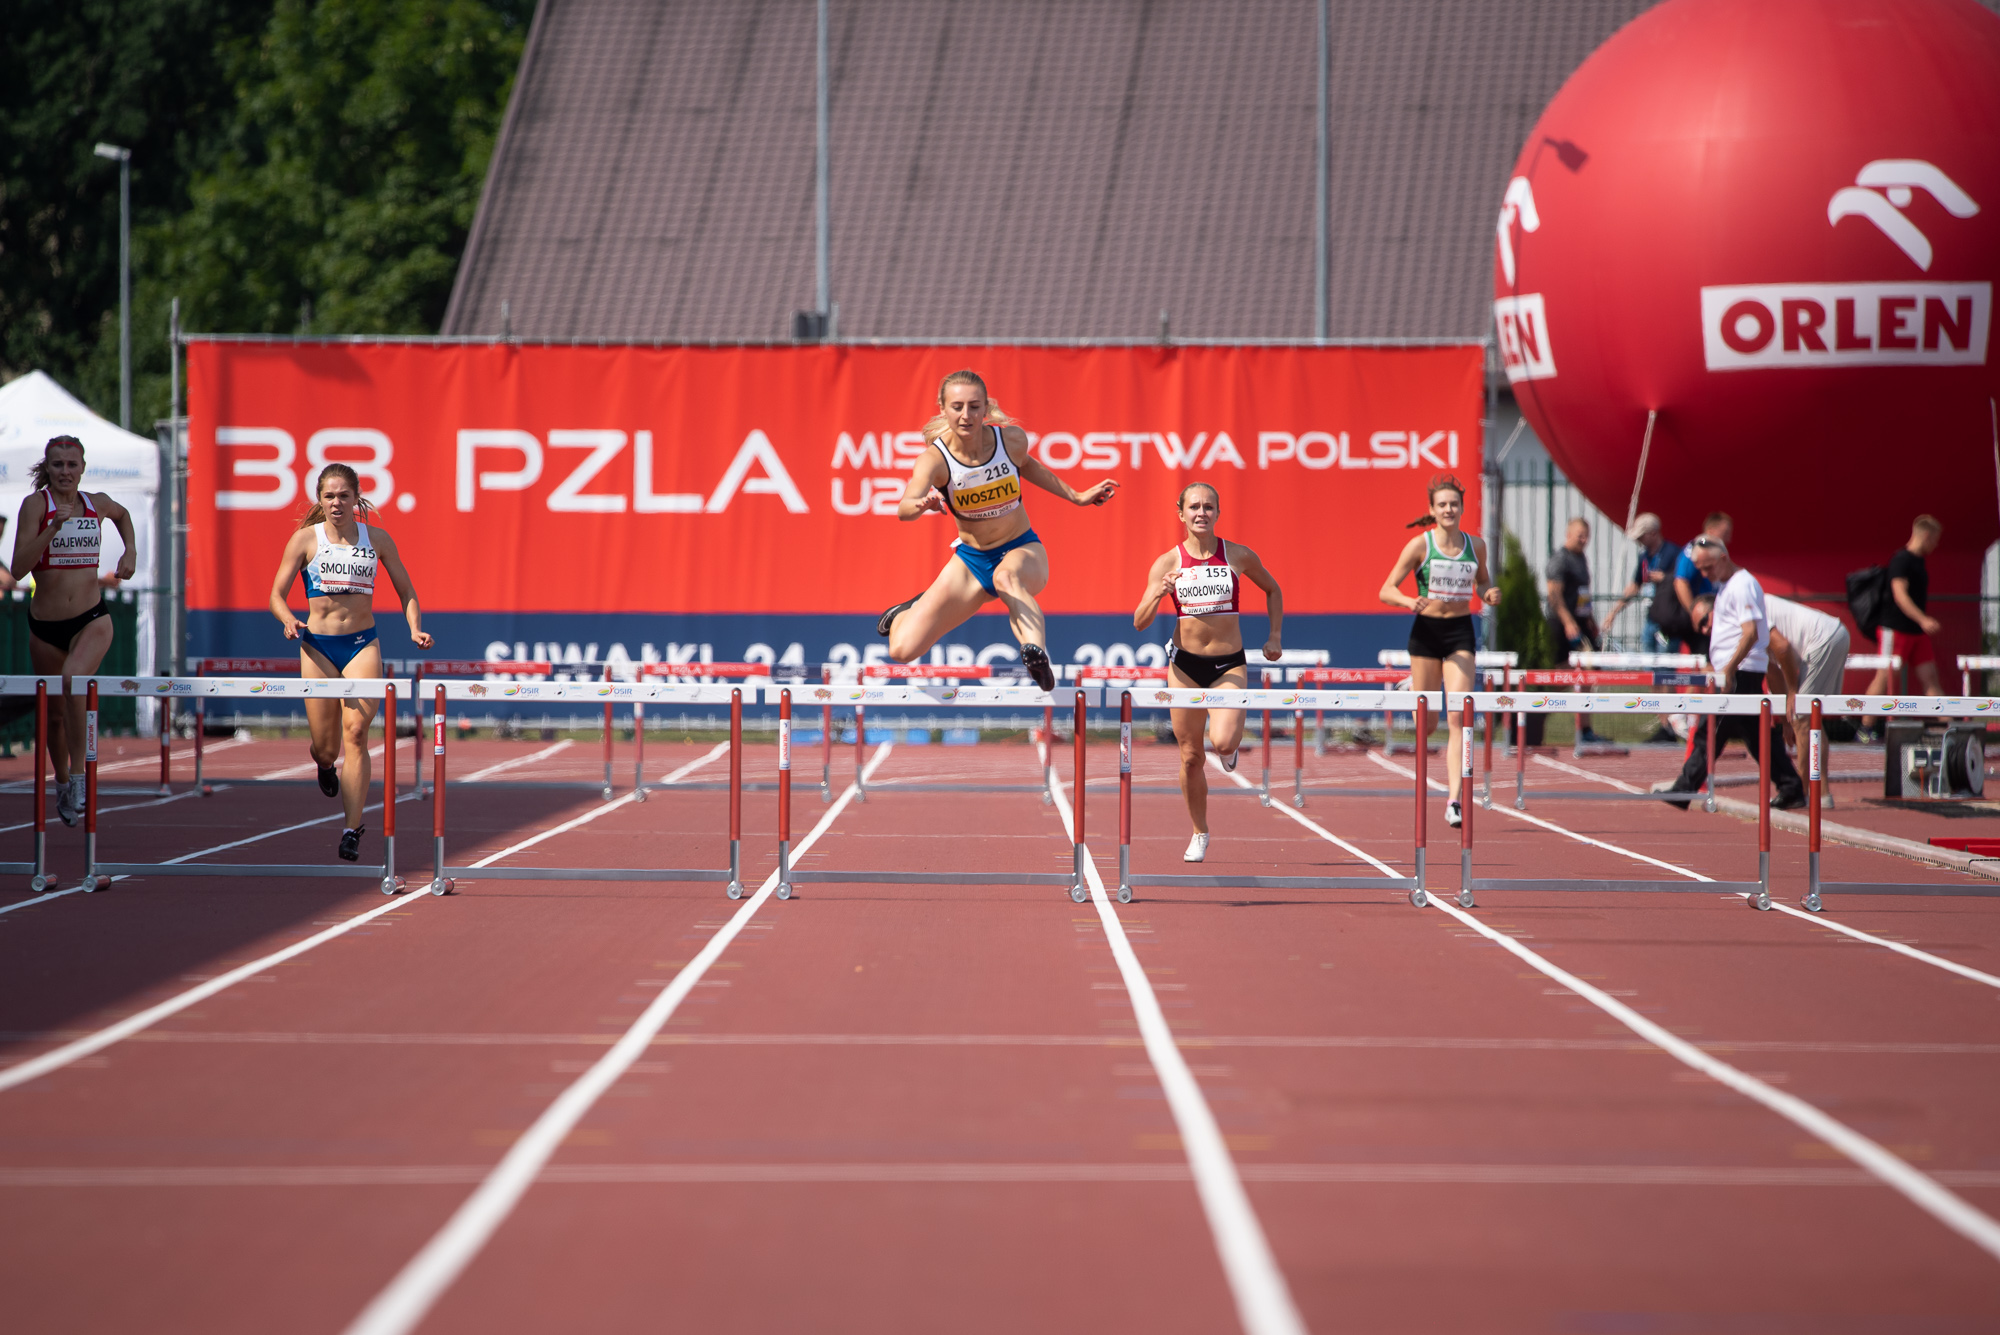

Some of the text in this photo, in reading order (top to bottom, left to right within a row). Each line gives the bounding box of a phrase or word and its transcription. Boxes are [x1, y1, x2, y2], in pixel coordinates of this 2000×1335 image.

[1720, 295, 1973, 354] ORLEN
[214, 426, 1459, 513] 38. PZLA MISOSTWA POLSKI
[984, 462, 1010, 481] 218
[956, 482, 1017, 507] WOSZTYL
[77, 519, 97, 530] 225
[52, 536, 99, 548] GAJEWSKA
[352, 547, 376, 559] 215
[320, 562, 373, 578] SMOLIŃSKA
[1205, 567, 1228, 578] 155
[1460, 563, 1472, 574] 70
[1178, 584, 1231, 598] SOKOŁOWSKA
[1553, 674, 1585, 684] PZLA
